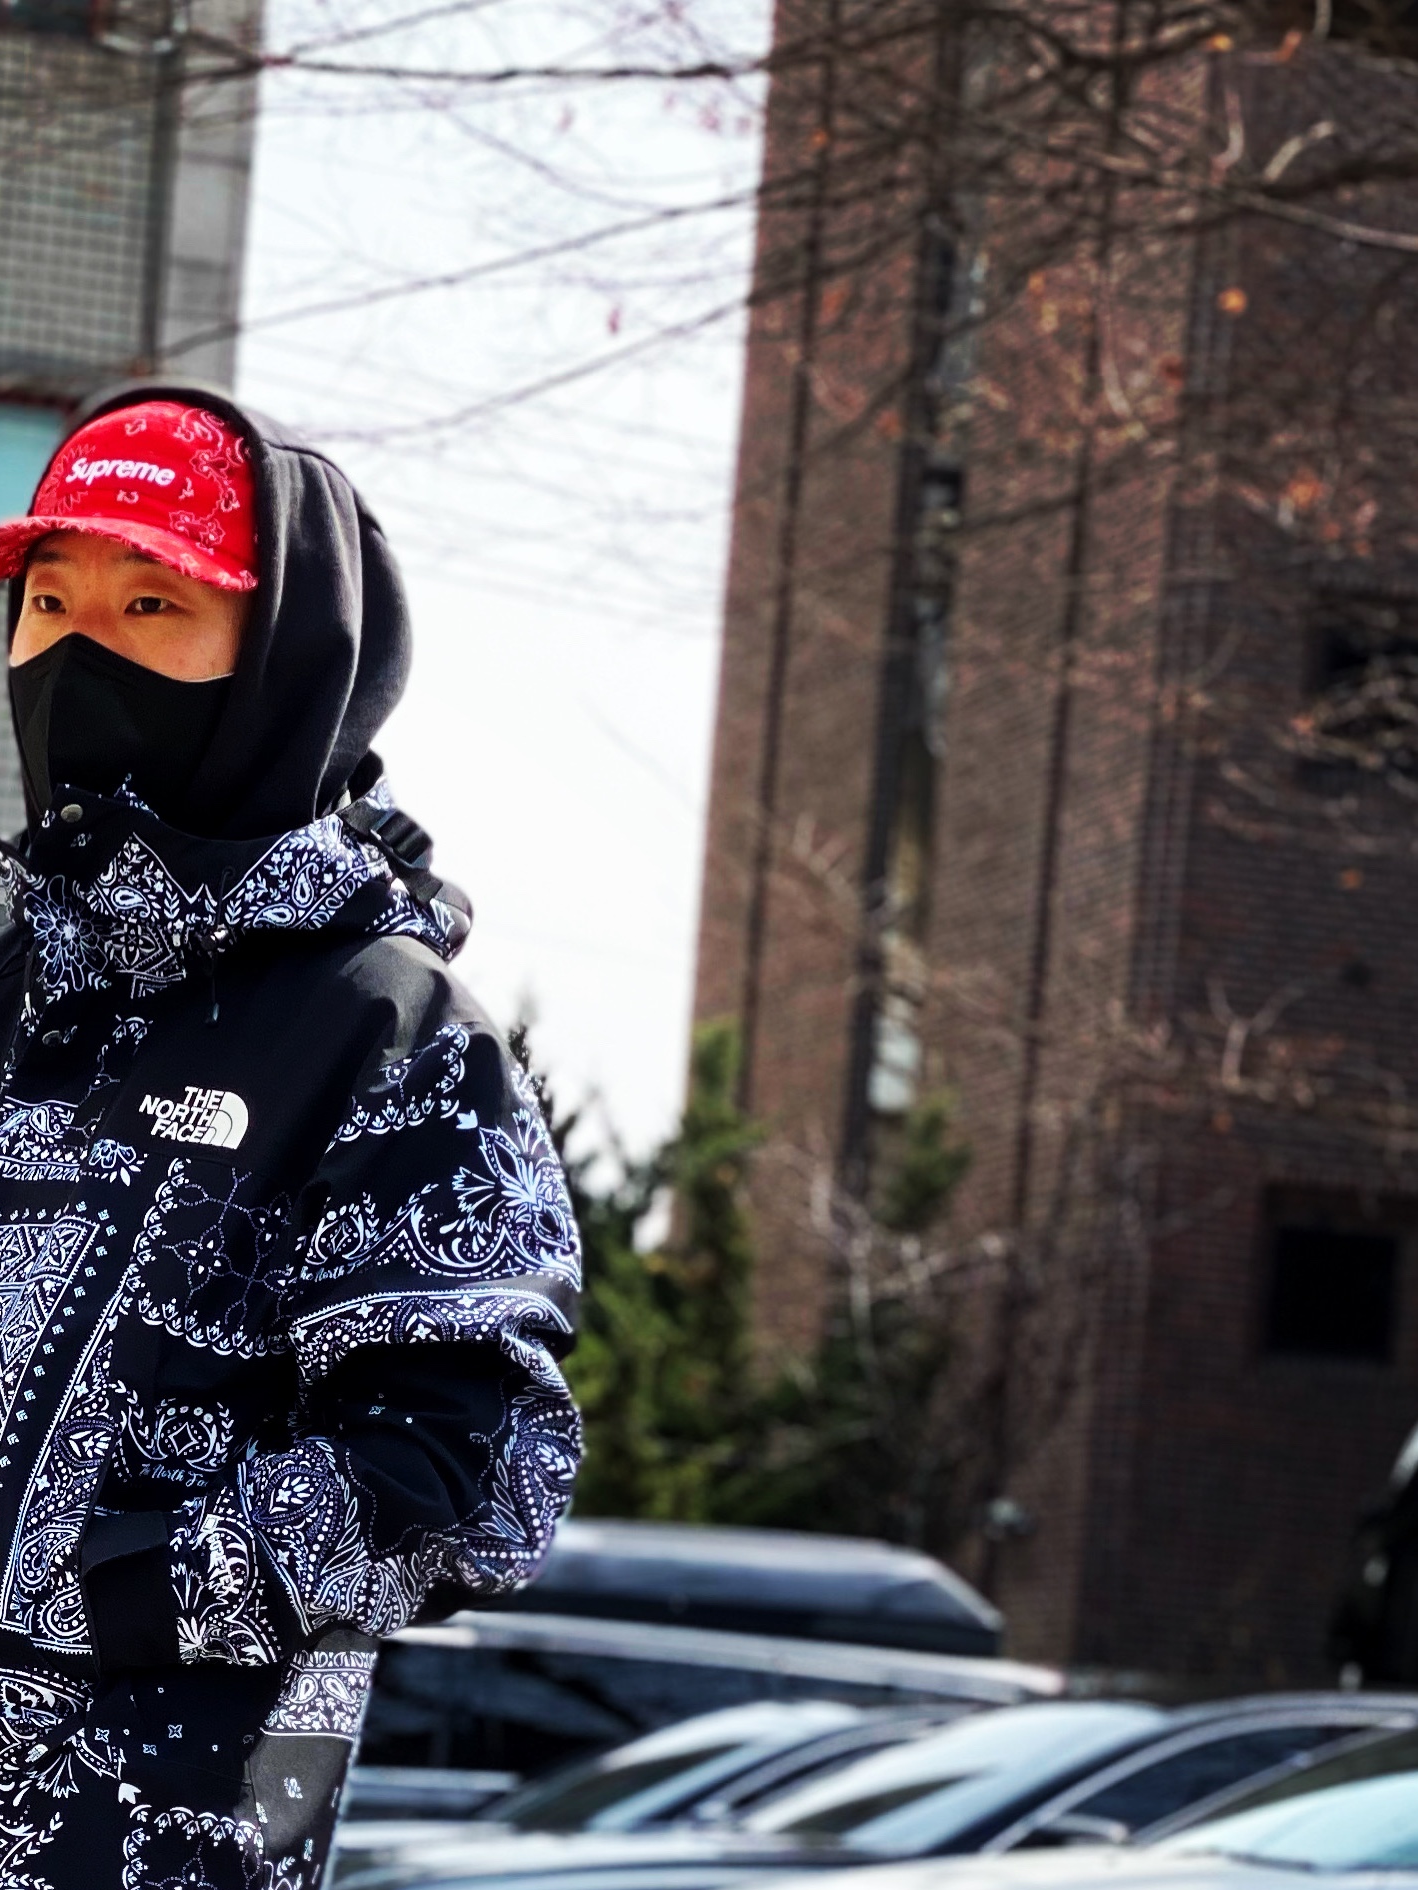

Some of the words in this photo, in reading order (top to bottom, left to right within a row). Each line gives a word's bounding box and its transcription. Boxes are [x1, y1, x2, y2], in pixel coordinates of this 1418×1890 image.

[65, 457, 176, 486] Supreme
[138, 1094, 217, 1127] NORTH
[183, 1085, 224, 1110] THE
[150, 1118, 208, 1144] FACE
[151, 1463, 185, 1481] North
